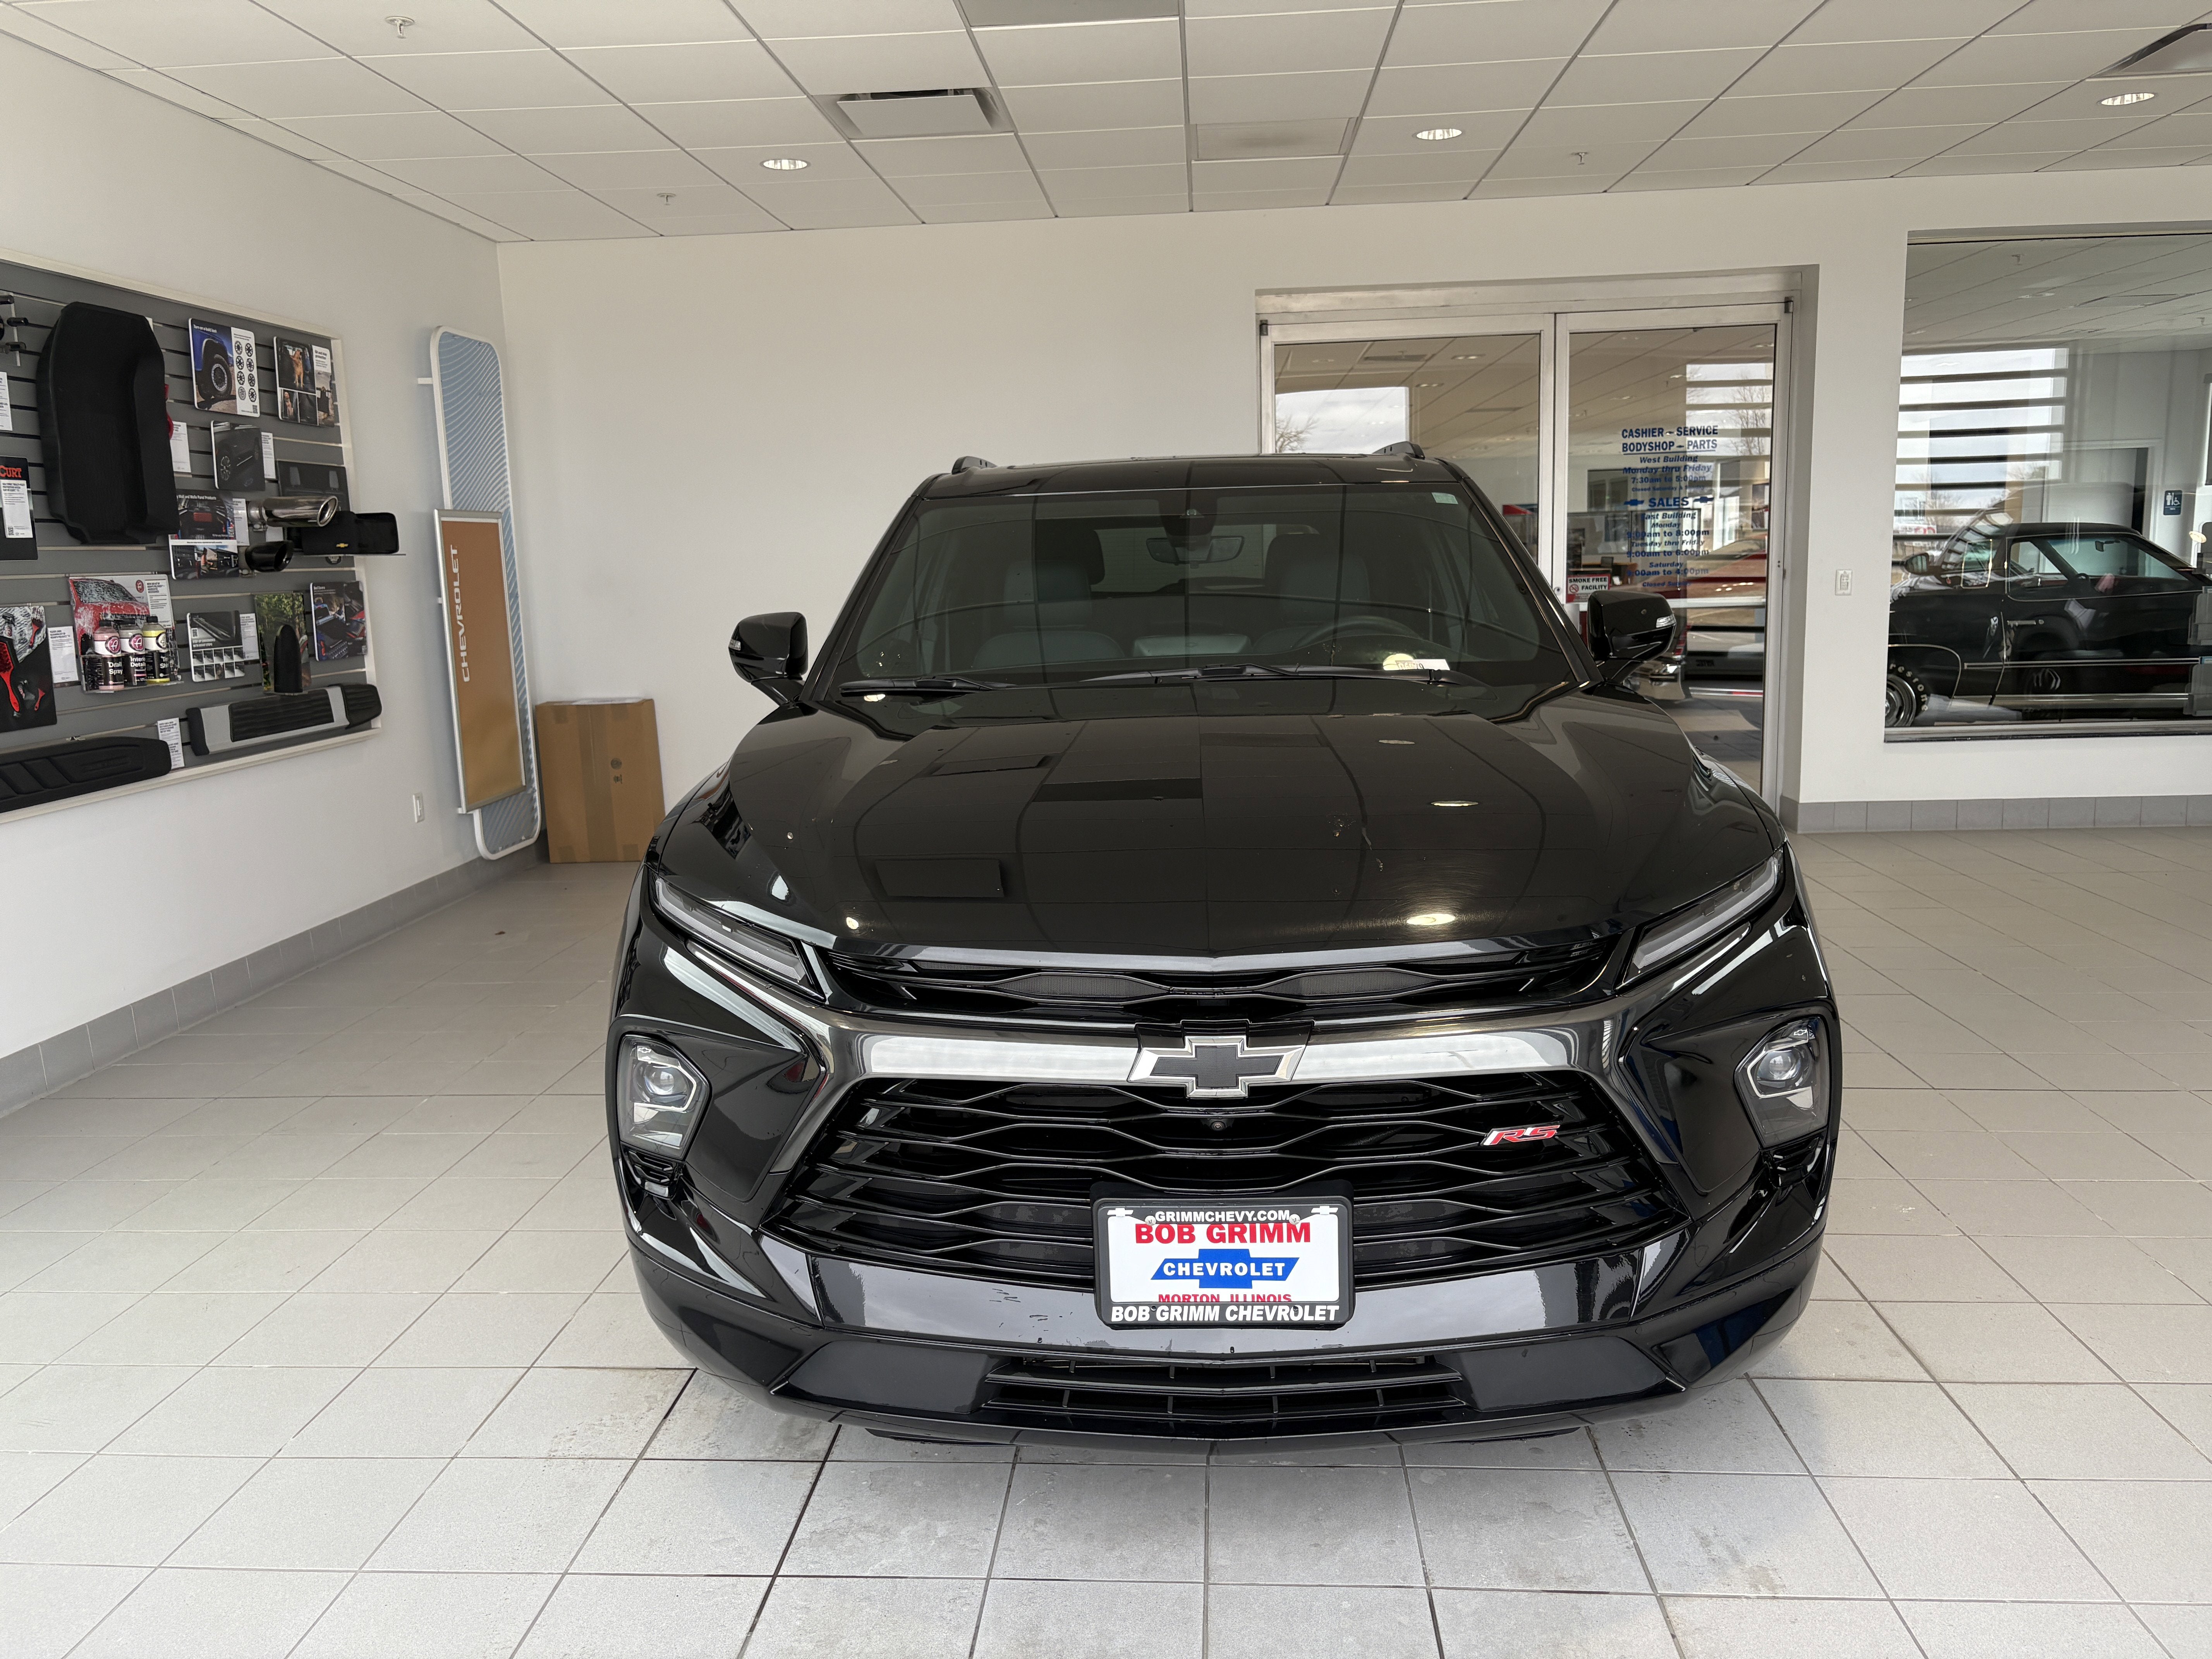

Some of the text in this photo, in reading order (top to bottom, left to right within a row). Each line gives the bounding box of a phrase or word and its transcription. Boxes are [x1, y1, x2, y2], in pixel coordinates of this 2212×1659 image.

[1621, 425, 1718, 438] CASHIER SERVICE
[1622, 439, 1717, 452] BODYSHOP PARTS
[1623, 466, 1659, 475] Monday
[1683, 464, 1712, 472] Friday
[1649, 496, 1689, 507] SALES
[450, 544, 470, 682] CHEVROLET
[1889, 663, 1929, 711] restone
[1483, 1125, 1561, 1146] RS
[1155, 1210, 1290, 1223] GRIMMCHEVY.COM
[1135, 1223, 1310, 1243] BOB GRIMM
[1163, 1262, 1285, 1276] CHEVROLET
[1159, 1294, 1220, 1302] MORTON
[1111, 1305, 1340, 1322] BOB GRIMM CHEVROLET
